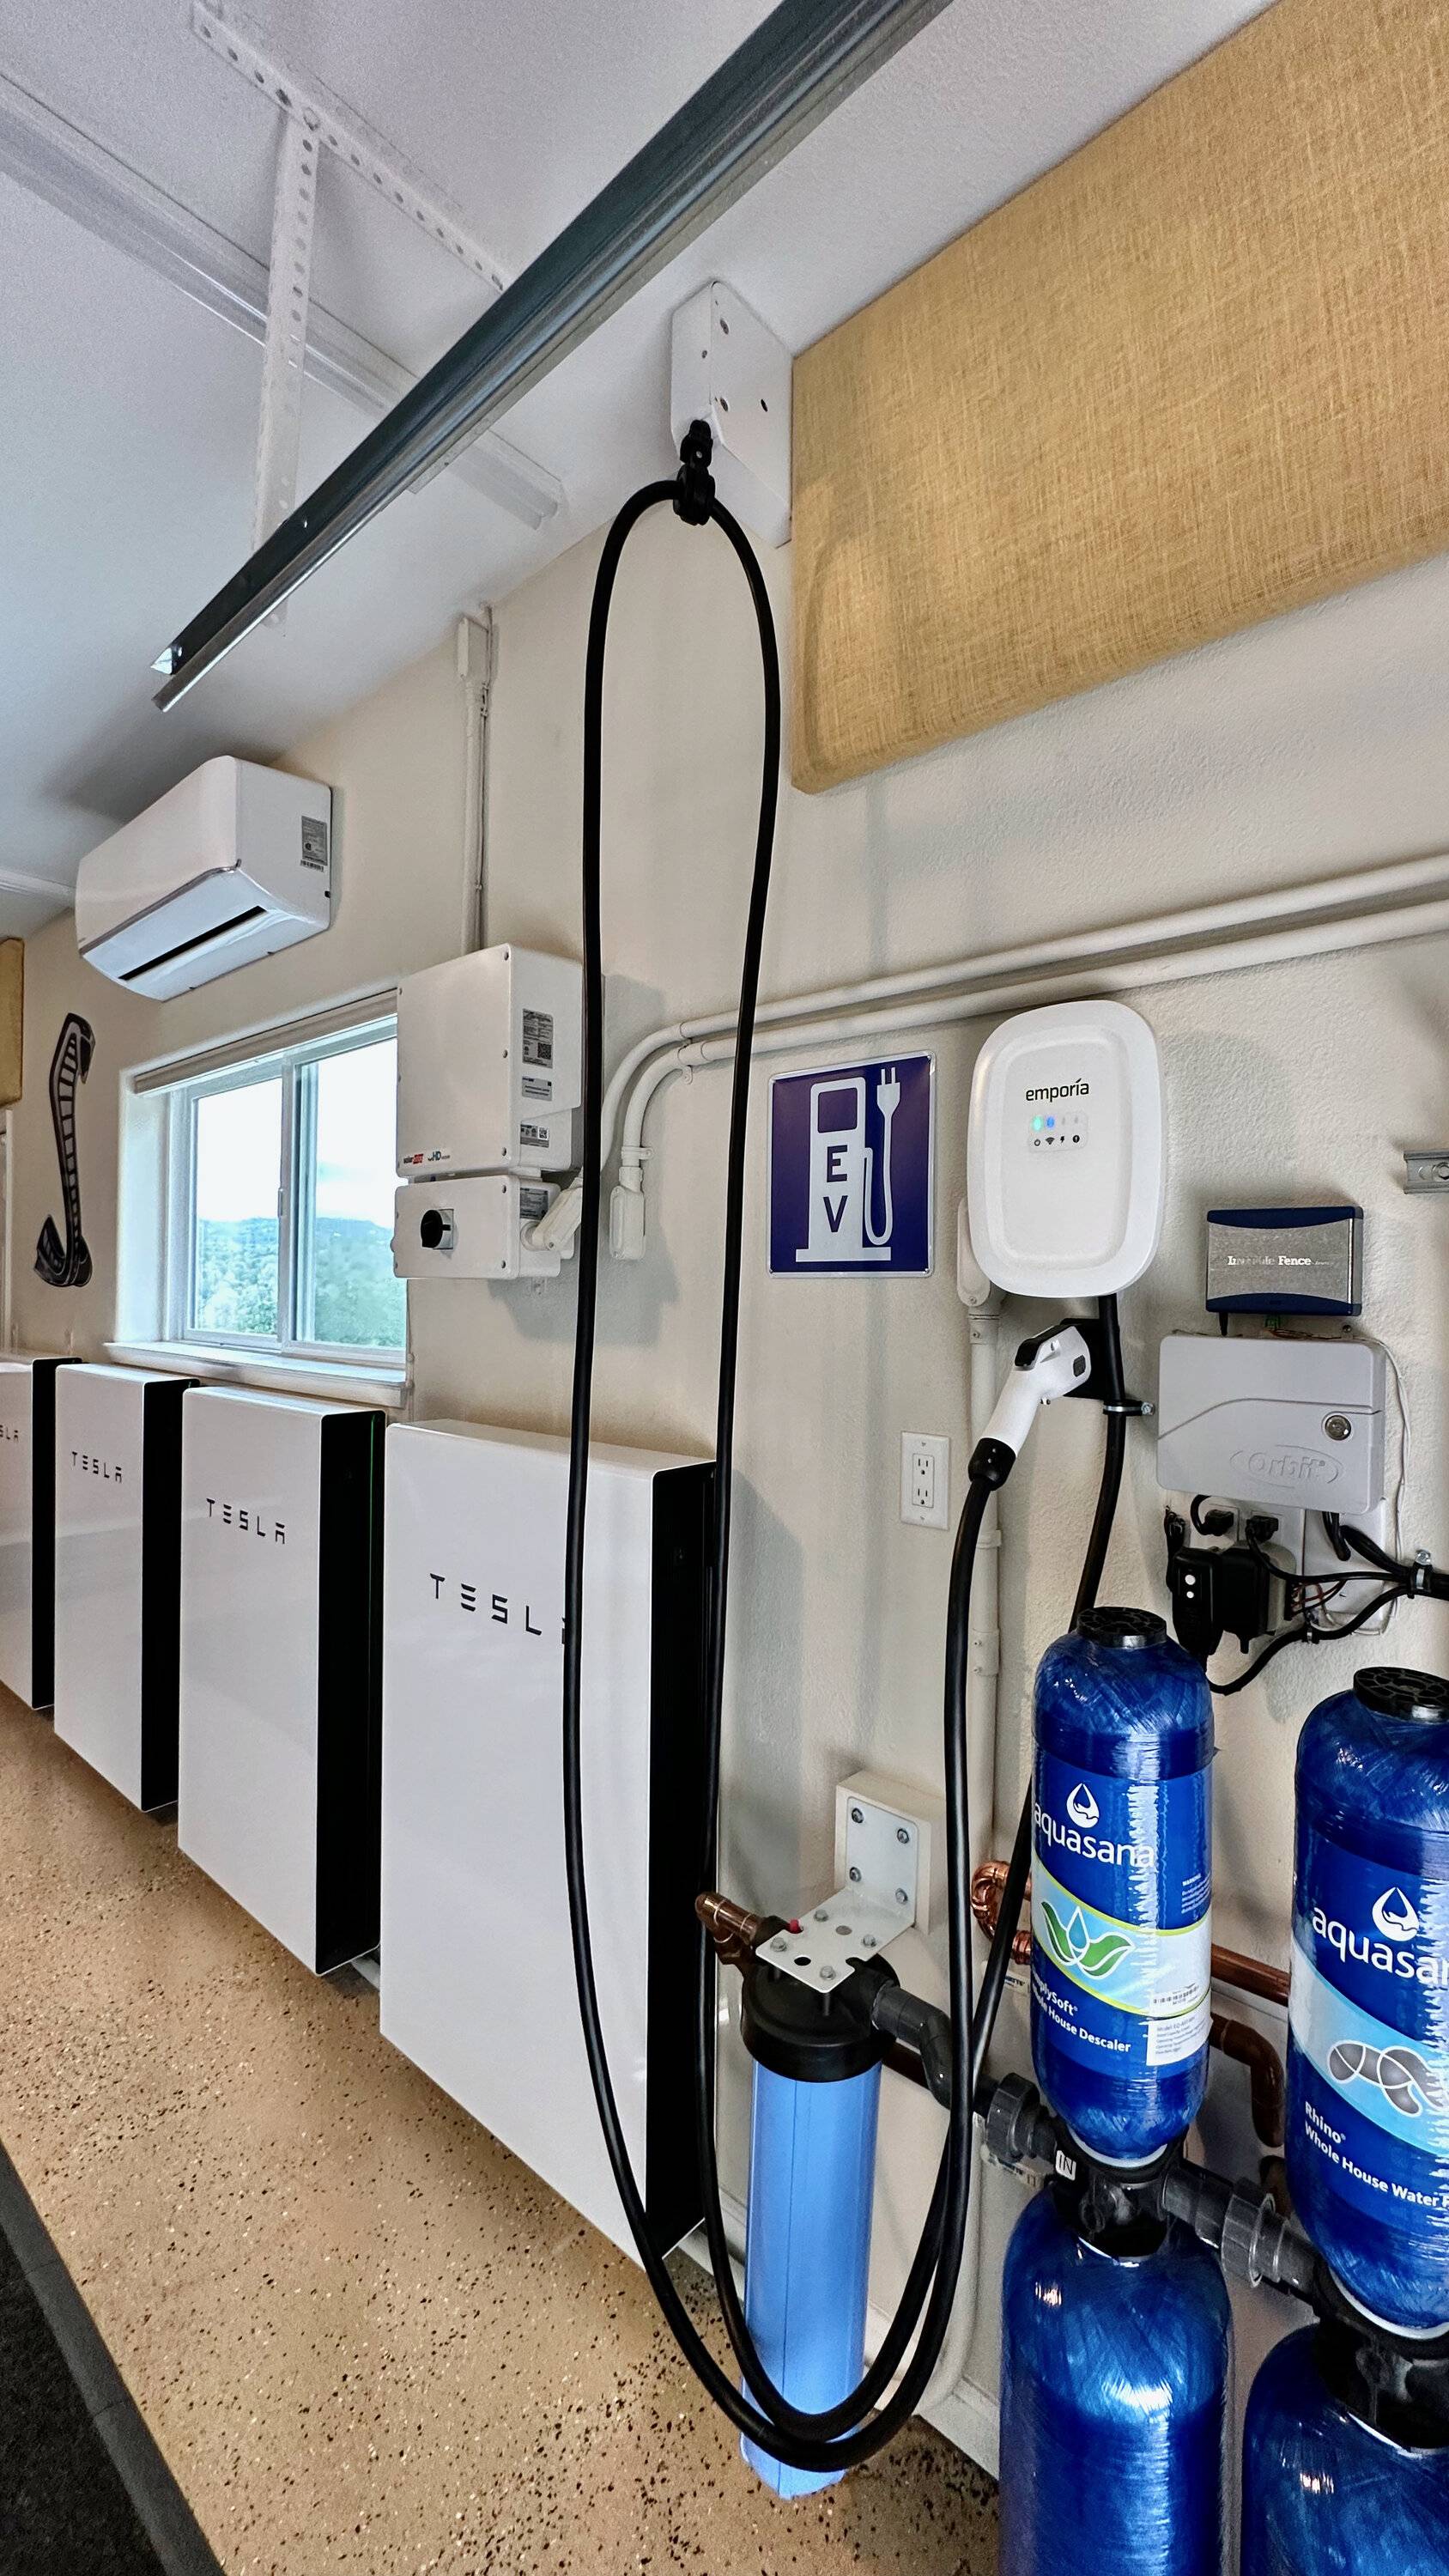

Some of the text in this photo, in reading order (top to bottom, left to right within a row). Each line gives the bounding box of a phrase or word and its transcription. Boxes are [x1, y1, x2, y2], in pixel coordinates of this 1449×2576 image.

[1278, 1255, 1312, 1266] Fence
[0, 1425, 19, 1443] SLA
[71, 1451, 122, 1483] TESLA
[206, 1498, 285, 1545] TESLA
[430, 1573, 566, 1644] TESL
[1034, 1802, 1155, 1868] aquasana
[1312, 1907, 1449, 1985] aquasa
[1049, 2006, 1077, 2035] House
[1079, 2027, 1131, 2052] Descaler
[1305, 2120, 1340, 2164] Whole
[1342, 2157, 1389, 2192] House
[1391, 2183, 1440, 2208] Water
